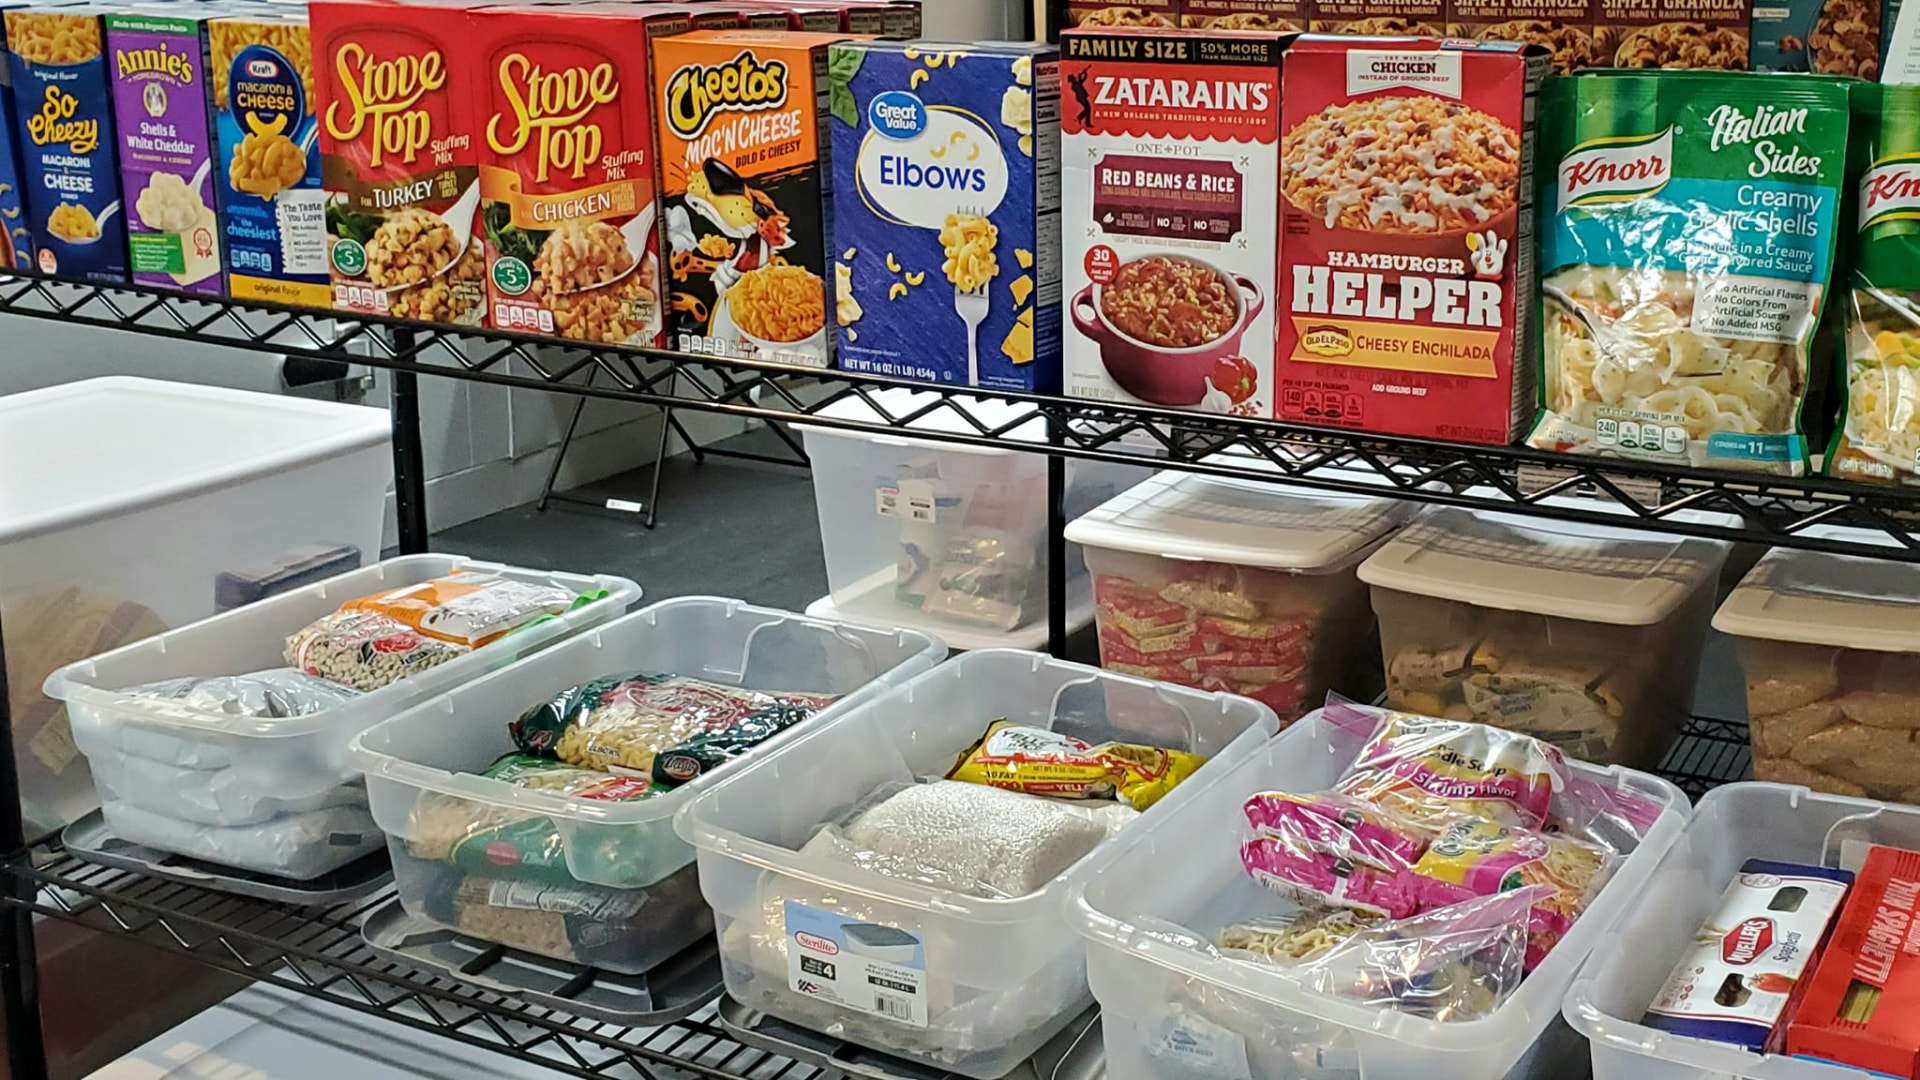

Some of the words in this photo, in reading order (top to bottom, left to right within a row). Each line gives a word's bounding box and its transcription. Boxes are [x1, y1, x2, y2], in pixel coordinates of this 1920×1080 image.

[1507, 8, 1538, 17] RAISINS
[1539, 9, 1545, 17] &
[1547, 8, 1585, 17] ALMONDS
[1663, 0, 1744, 10] GRANOLA
[1606, 10, 1627, 19] OATS,
[1629, 10, 1657, 19] HONEY,
[1659, 10, 1690, 19] RAISINS
[1693, 11, 1698, 19] &
[1701, 10, 1740, 19] ALMONDS
[1069, 38, 1137, 57] FAMILY
[1144, 41, 1187, 59] SIZE
[1201, 43, 1226, 54] 50%
[1231, 44, 1268, 55] MORE
[117, 43, 193, 84] Annie's
[252, 63, 273, 75] Kraft
[1371, 62, 1436, 74] CHICKEN
[237, 82, 285, 94] macaroni
[286, 85, 293, 95] &
[326, 42, 446, 141] Stove
[668, 52, 785, 135] Cheetos
[1095, 77, 1268, 111] ZATARAIN'S
[43, 85, 79, 120] So
[487, 53, 619, 154] Stove
[876, 102, 917, 120] Great
[886, 117, 917, 131] Value
[1124, 112, 1160, 120] ORLEANS
[1163, 114, 1207, 122] TRADITION
[1219, 116, 1242, 124] SINCE
[27, 114, 99, 154] Cheezy
[140, 122, 168, 137] Shells
[169, 125, 176, 137] &
[366, 103, 430, 168] Top
[738, 109, 802, 149] CHEESE
[1704, 104, 1808, 151] Italian
[127, 135, 153, 150] White
[155, 138, 195, 154] Cheddar
[431, 135, 469, 154] Stuffing
[529, 116, 601, 183] Top
[42, 154, 90, 168] MACARONI
[435, 152, 453, 166] Mix
[601, 150, 643, 169] Stuffing
[735, 155, 757, 169] BOLD
[759, 153, 766, 162] &
[768, 140, 801, 160] CHEESY
[1748, 141, 1821, 178] Sides
[606, 167, 626, 182] Mix
[880, 155, 986, 192] Elbows
[1102, 168, 1131, 186] RED
[1135, 170, 1182, 190] BEANS
[1185, 173, 1197, 190] &
[1201, 174, 1235, 192] RICE
[1562, 155, 1666, 193] Knorr
[44, 173, 94, 193] CHEESE
[372, 179, 434, 208] TURKEY
[1738, 185, 1823, 216] Creamy
[283, 204, 297, 213] The
[299, 203, 321, 212] Taste
[533, 192, 611, 222] CHICKEN
[287, 214, 301, 222] You
[303, 213, 322, 222] Love
[1157, 217, 1170, 227] NO
[1194, 220, 1207, 230] NO
[345, 251, 354, 265] 5
[1093, 249, 1110, 262] 30
[1740, 243, 1752, 254] in
[1754, 246, 1763, 254] a
[1766, 244, 1814, 262] Creamy
[1327, 251, 1465, 275] HAMBURGER
[1776, 258, 1813, 273] Sauce
[507, 269, 517, 284] 5
[1292, 265, 1502, 328] HELPER
[1732, 284, 1775, 297] Artificial
[1777, 288, 1808, 301] Flavors
[1715, 295, 1728, 304] No
[1730, 295, 1761, 307] Colors
[1763, 300, 1787, 310] From
[1713, 306, 1754, 318] Artificial
[1712, 318, 1725, 326] No
[1727, 319, 1758, 330] Added
[1760, 322, 1782, 332] MSG
[1306, 335, 1320, 345] OLD
[1357, 335, 1408, 353] CHEESY
[1412, 340, 1492, 361] ENCHILADA
[845, 358, 858, 369] NET
[859, 359, 870, 371] WT
[872, 362, 881, 373] 16
[883, 362, 893, 374] OZ
[902, 365, 915, 378] LB)
[916, 367, 936, 381] 454g
[1598, 421, 1616, 433] 240
[1748, 440, 1764, 455] 11
[1480, 785, 1517, 798] Flavor
[800, 935, 832, 952] Sterilite
[1727, 919, 1771, 963] MUELLER'S
[1773, 930, 1802, 963] Spaghetti
[1853, 906, 1910, 983] SPAGHETTI
[823, 965, 833, 978] 4
